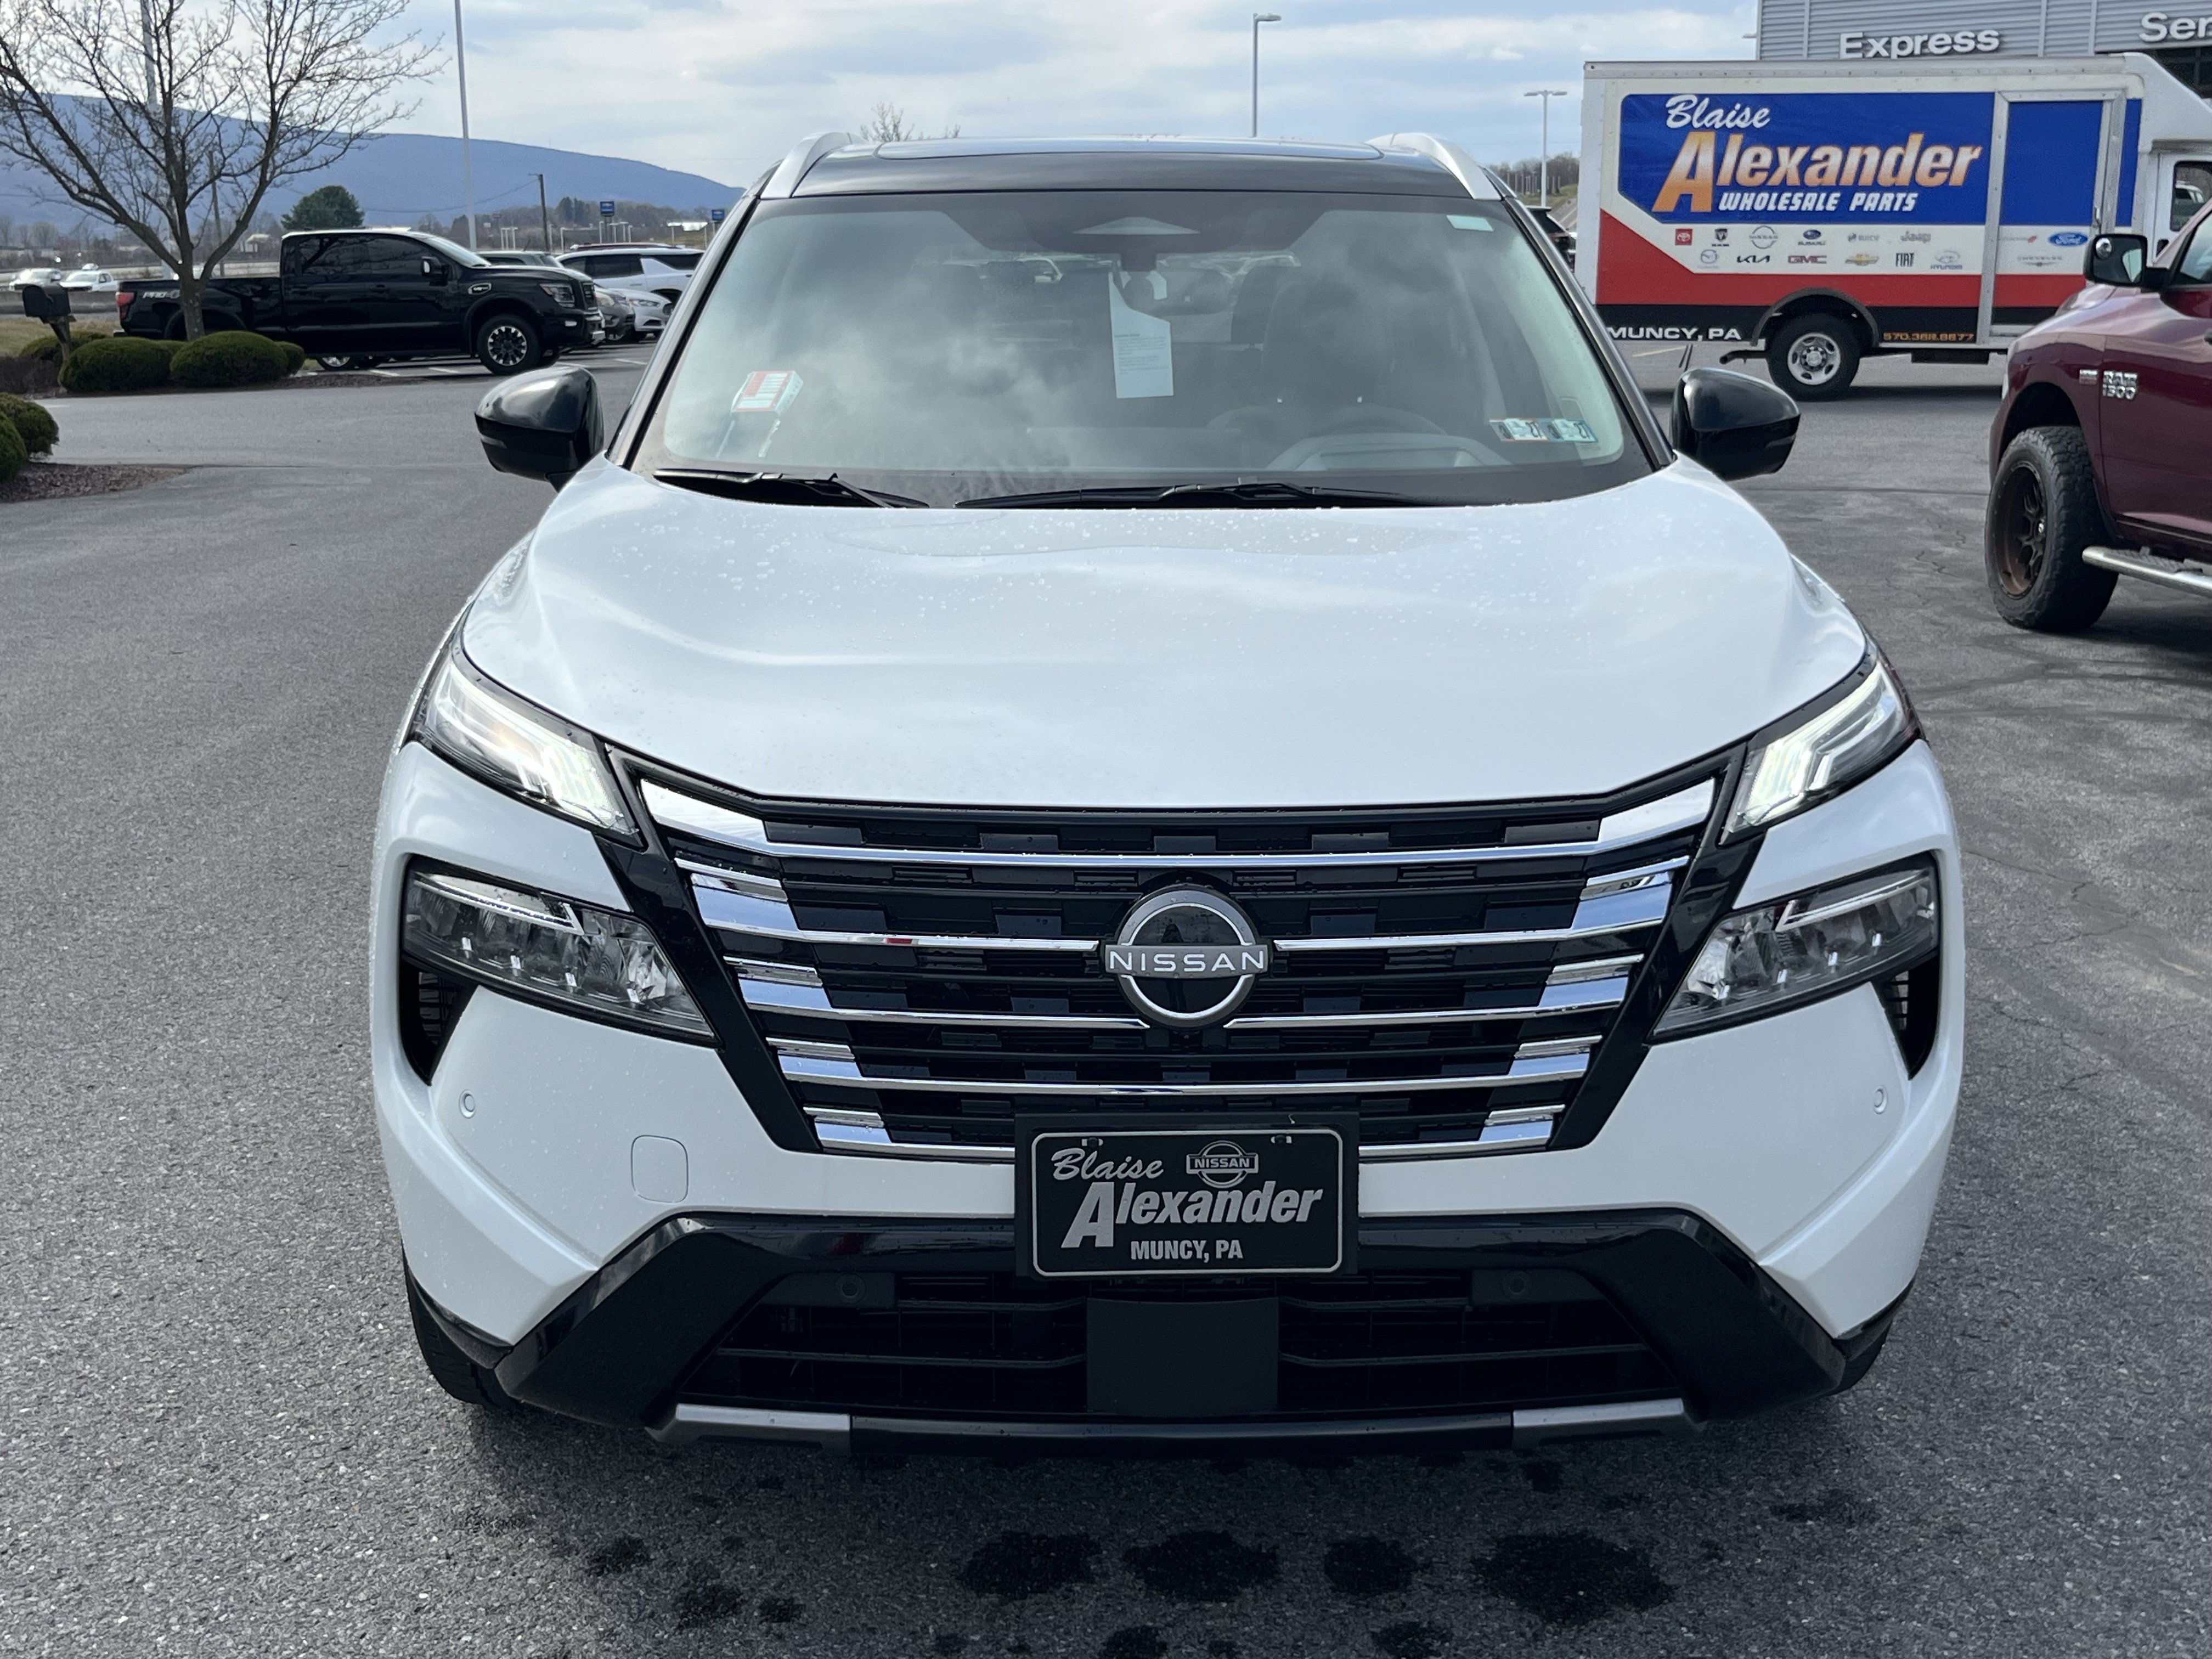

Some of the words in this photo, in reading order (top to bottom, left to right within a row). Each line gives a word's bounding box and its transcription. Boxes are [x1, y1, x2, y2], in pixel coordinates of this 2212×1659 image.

[1839, 30, 2000, 59] Express
[1666, 94, 1771, 129] Blaise
[1651, 131, 1982, 212] Alexander
[1718, 193, 1838, 211] WHOLESALE
[1849, 193, 1918, 211] PARTS
[1900, 231, 1932, 244] Jeep
[2055, 234, 2082, 245] Ford
[1736, 255, 1770, 263] KIA
[1787, 255, 1827, 264] GMC
[1895, 252, 1915, 267] FIAT
[1606, 327, 1703, 342] MUNCY,
[1708, 328, 1741, 340] PA
[2103, 370, 2137, 386] RAM
[1110, 950, 1264, 972] NISSAN
[1051, 1148, 1164, 1180] Blaise
[1194, 1158, 1250, 1169] NISSAN
[1061, 1181, 1323, 1248] Alexander
[1131, 1240, 1209, 1263] MUNCY,
[1215, 1240, 1243, 1259] PA
